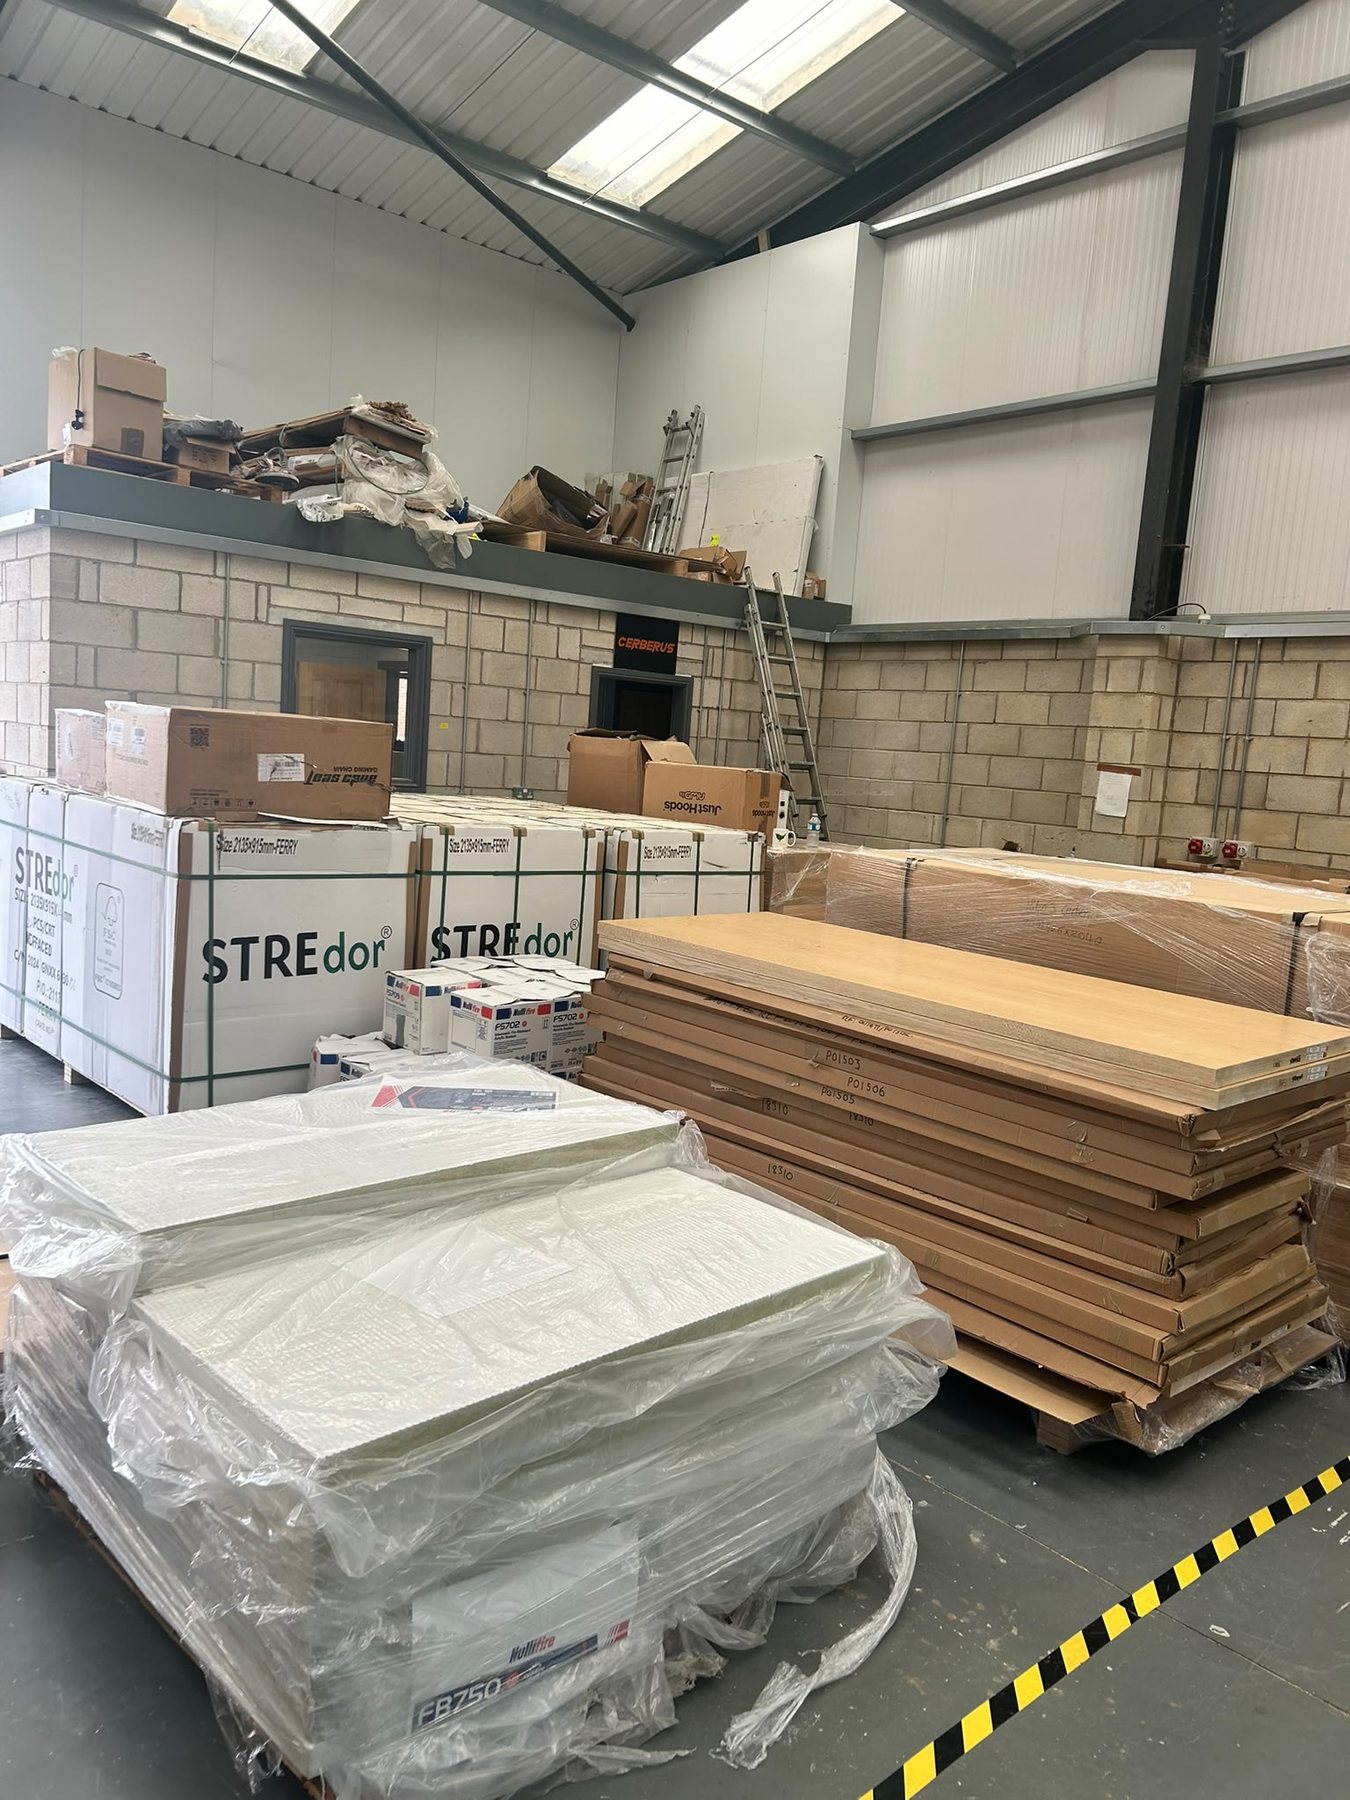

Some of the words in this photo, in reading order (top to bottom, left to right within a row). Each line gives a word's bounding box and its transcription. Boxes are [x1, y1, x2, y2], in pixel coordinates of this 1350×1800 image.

[617, 636, 675, 654] CERBERUS
[333, 765, 351, 773] CHAIR
[216, 836, 233, 852] Size
[494, 1021, 521, 1031] FS702
[553, 1013, 578, 1023] FS702
[767, 1163, 794, 1181] 18310
[508, 1635, 557, 1664] Nullifire
